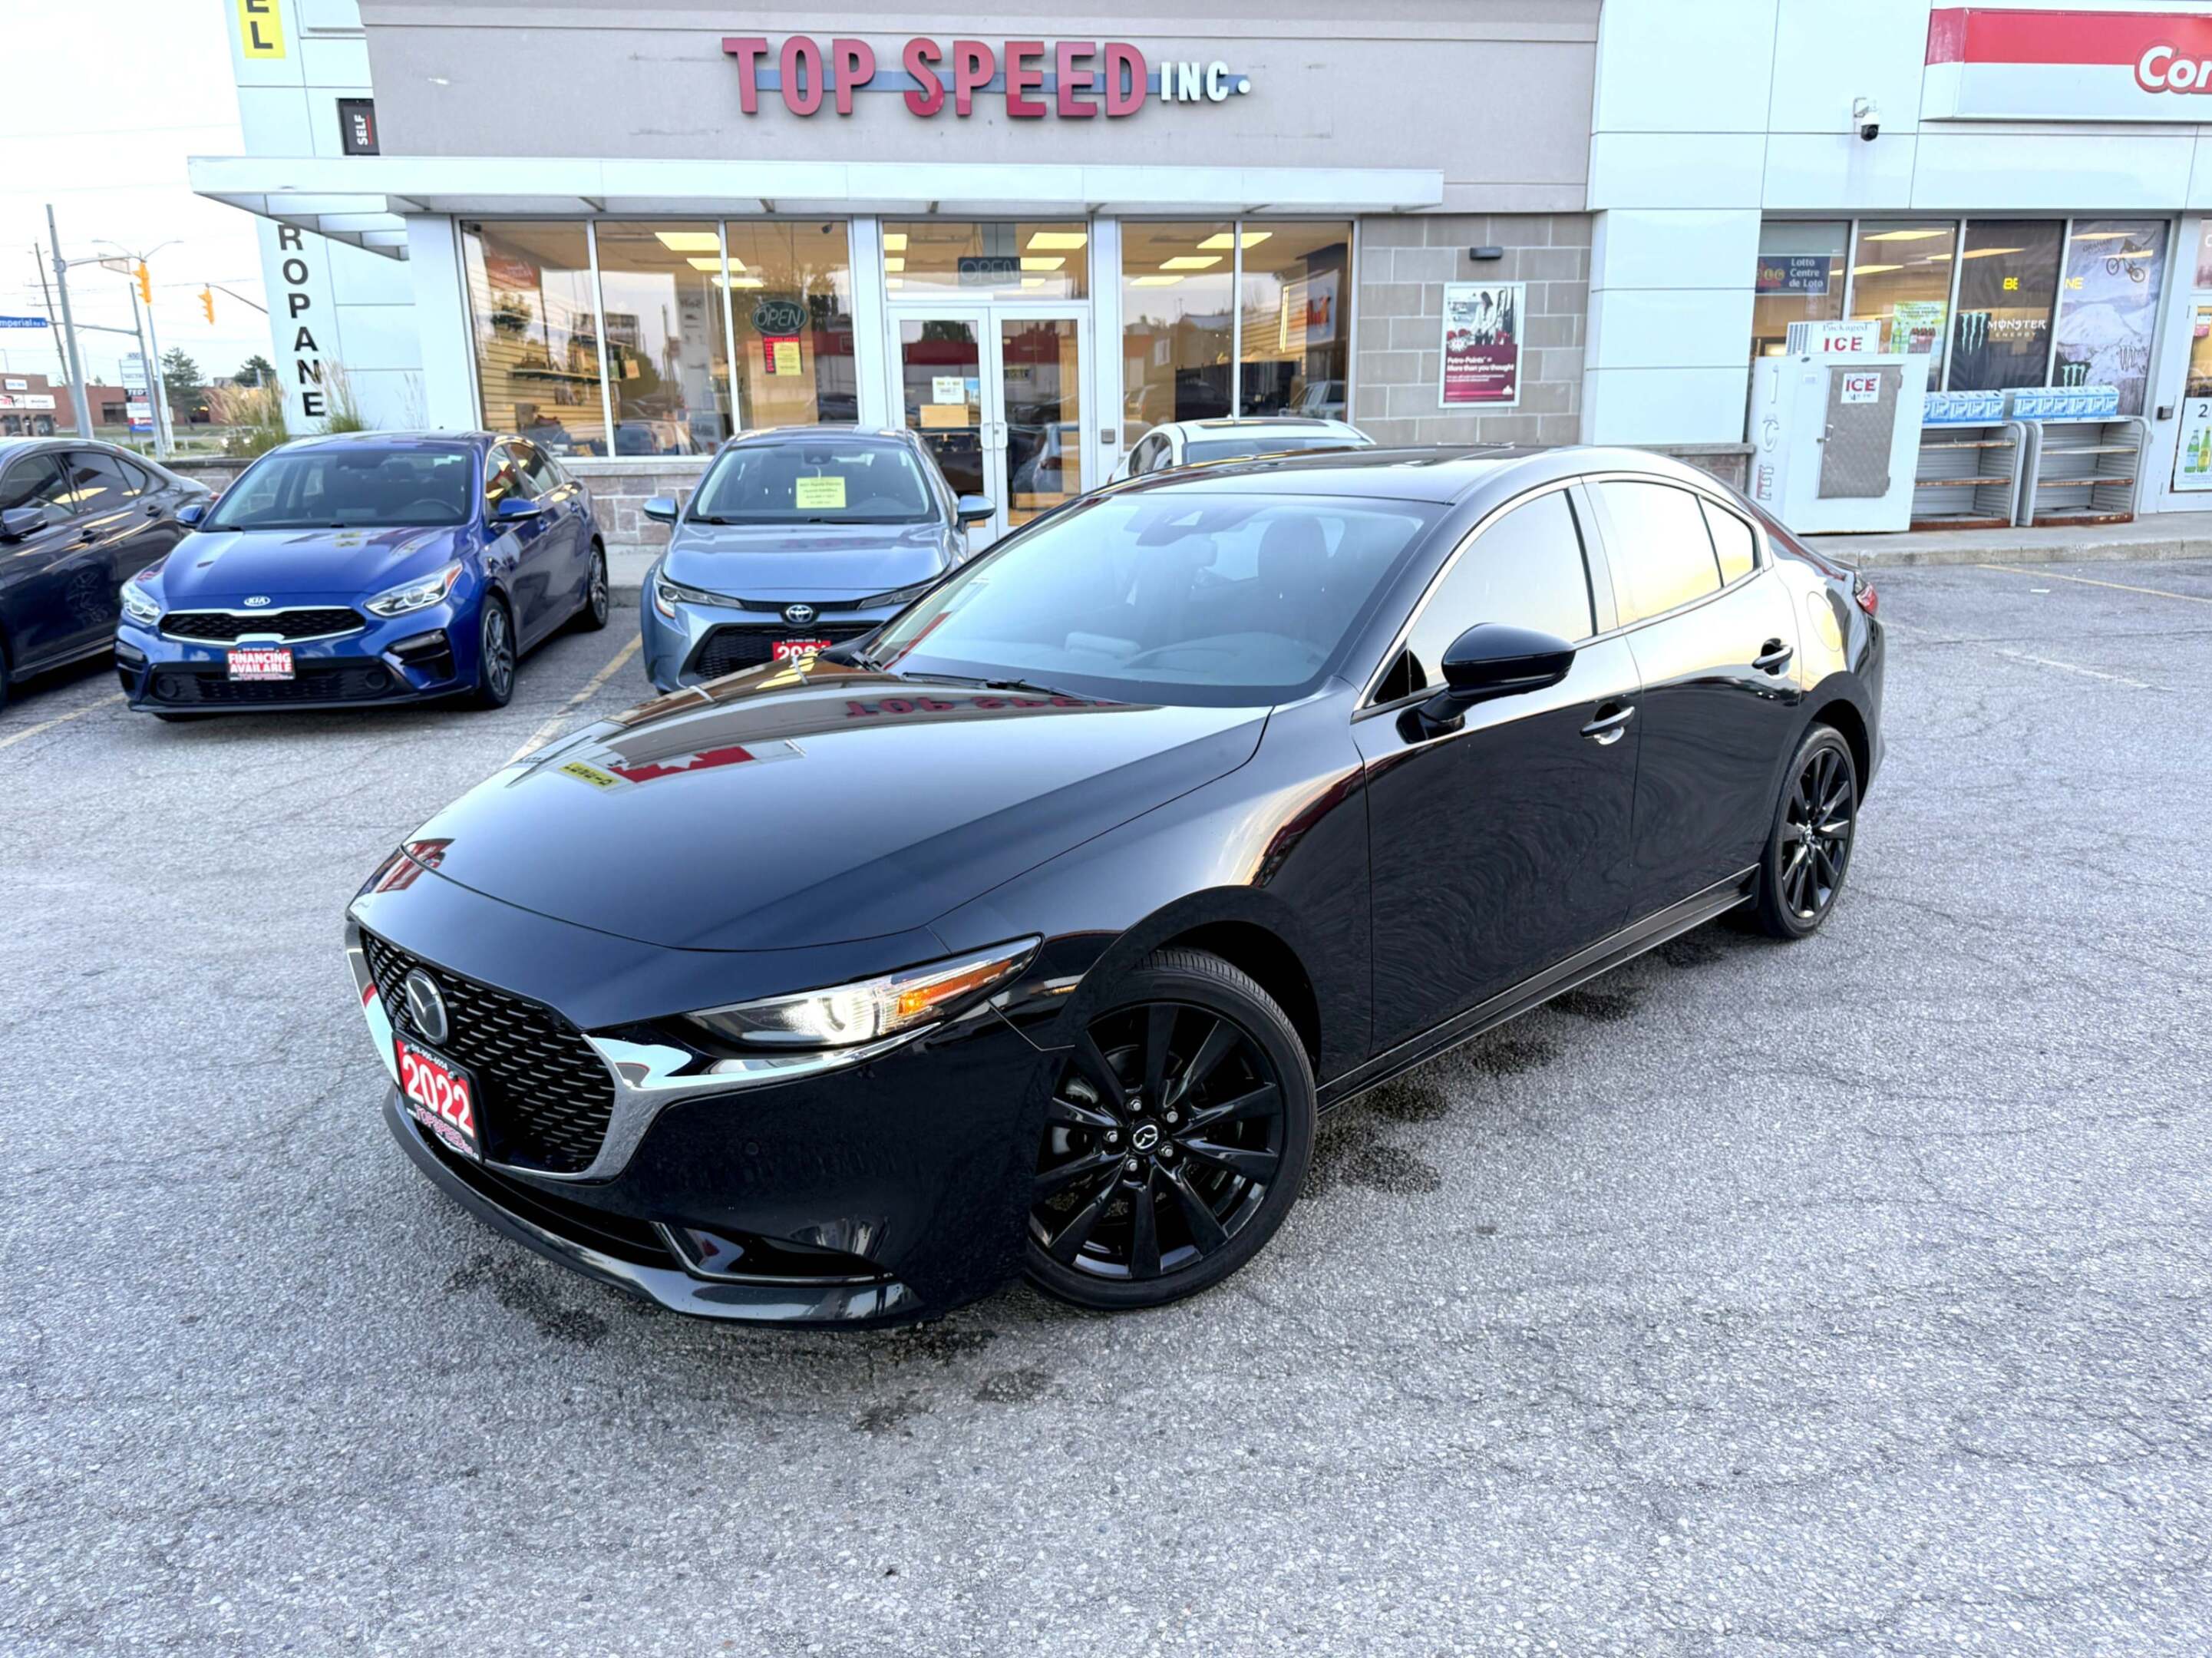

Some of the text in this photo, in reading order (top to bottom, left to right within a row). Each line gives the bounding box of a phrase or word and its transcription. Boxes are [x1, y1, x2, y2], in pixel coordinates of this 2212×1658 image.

[721, 35, 1251, 117] TOP SPEED INC.
[354, 114, 368, 145] SELF
[1791, 258, 1816, 266] Lotto
[961, 259, 1020, 282] OPEN
[1789, 269, 1820, 277] Centre
[1789, 279, 1824, 289] de Loto
[277, 223, 326, 417] ROPANE
[754, 306, 801, 326] OPEN
[0, 319, 32, 328] mperial
[1987, 319, 2046, 331] MONSTER
[1824, 336, 1863, 352] ICE
[1491, 364, 1514, 372] thought
[1845, 378, 1877, 392] ICE
[245, 596, 269, 606] KIA
[228, 652, 292, 664] FINANCING
[230, 663, 292, 673] AVAILABLE
[403, 1054, 474, 1138] 2022
